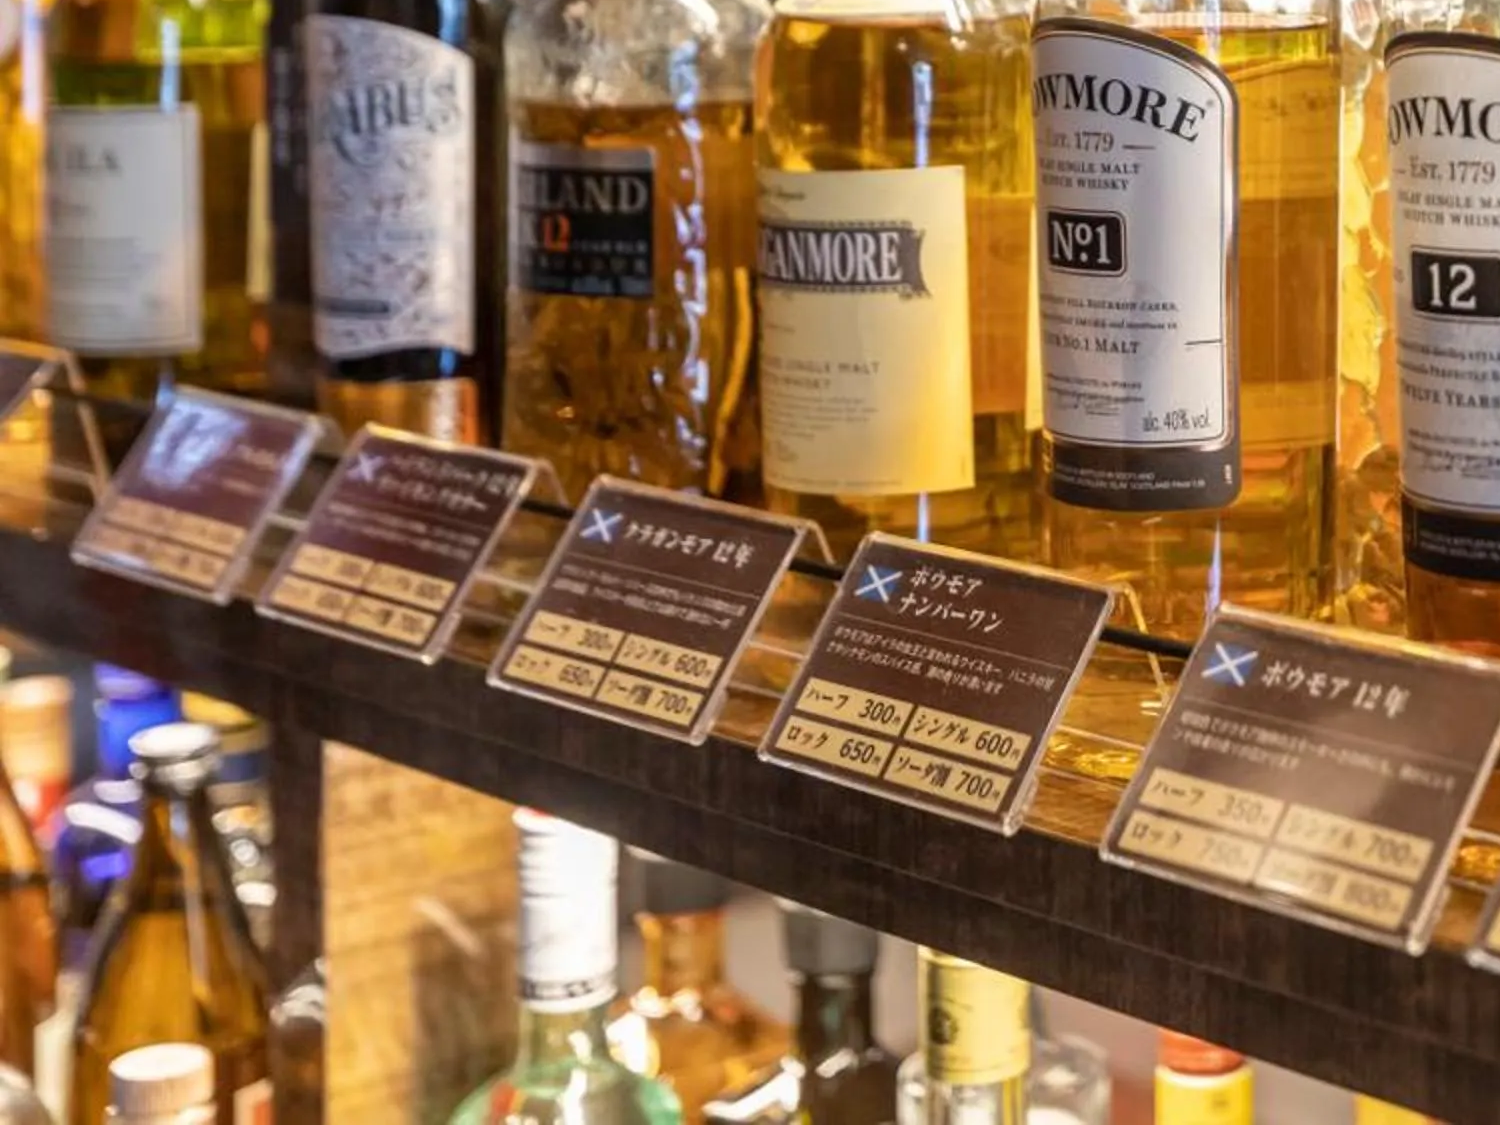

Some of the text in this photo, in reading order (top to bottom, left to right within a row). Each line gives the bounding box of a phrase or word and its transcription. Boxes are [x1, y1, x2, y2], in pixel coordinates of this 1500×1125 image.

[1074, 131, 1115, 153] 1779
[1100, 162, 1142, 175] MALT
[1449, 159, 1497, 185] 1779
[1429, 261, 1477, 310] 12
[1095, 338, 1141, 354] MALT
[910, 566, 984, 596] ボウモア
[897, 593, 1004, 633] ナンバーワン
[1260, 660, 1351, 701] ボウモア
[806, 686, 902, 726] ハーフ 300円
[787, 727, 882, 766] ロック 650円
[913, 713, 1021, 759] シングル 600円
[954, 770, 1000, 800] 700円
[1152, 777, 1206, 806] ハーフ
